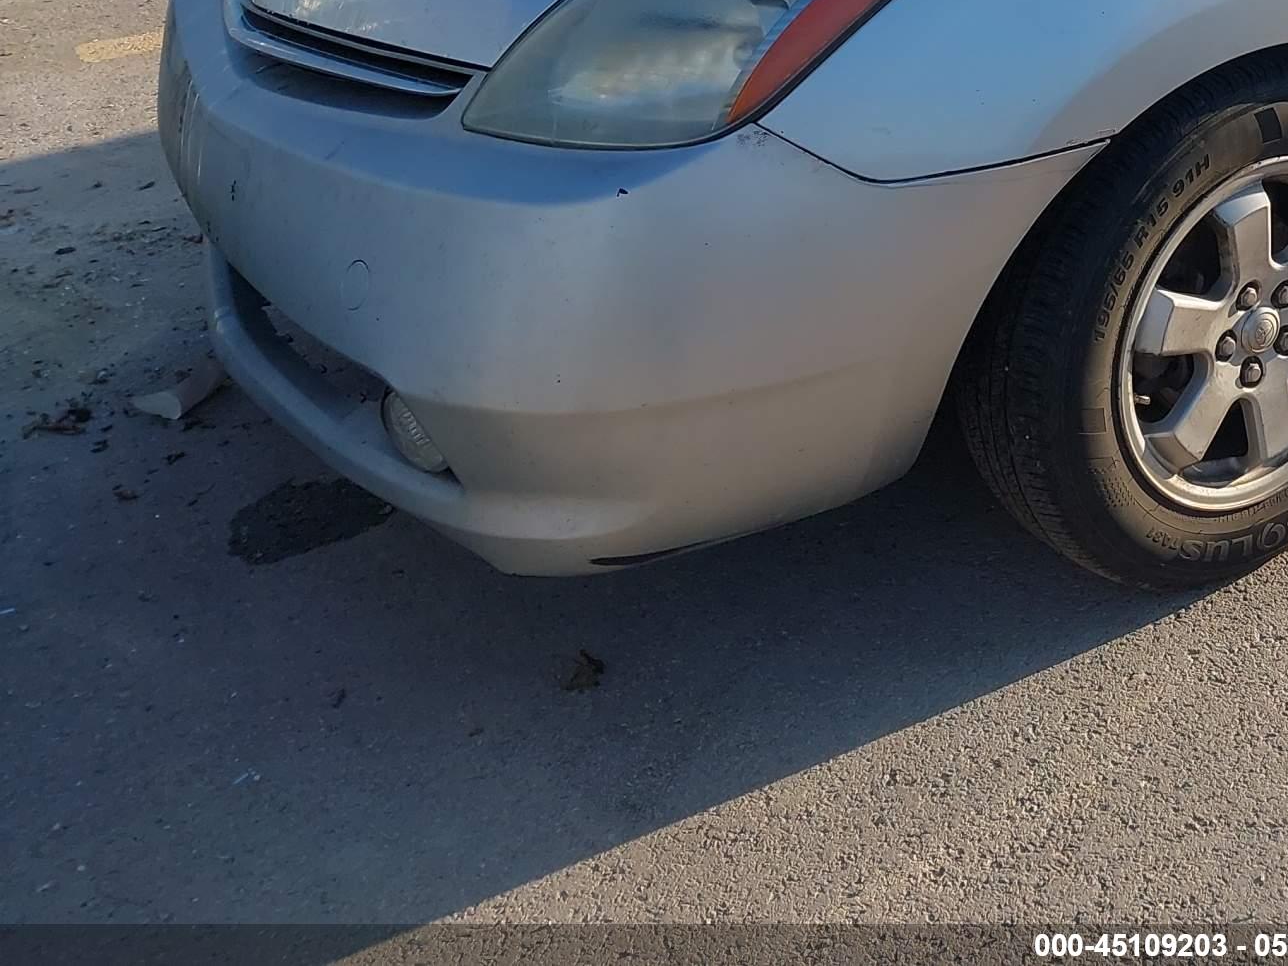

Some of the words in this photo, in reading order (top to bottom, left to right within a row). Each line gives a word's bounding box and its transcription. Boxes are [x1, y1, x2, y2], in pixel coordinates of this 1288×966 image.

[1094, 250, 1136, 344] 195/65
[1133, 196, 1170, 250] R15
[1172, 153, 1211, 198] 91H
